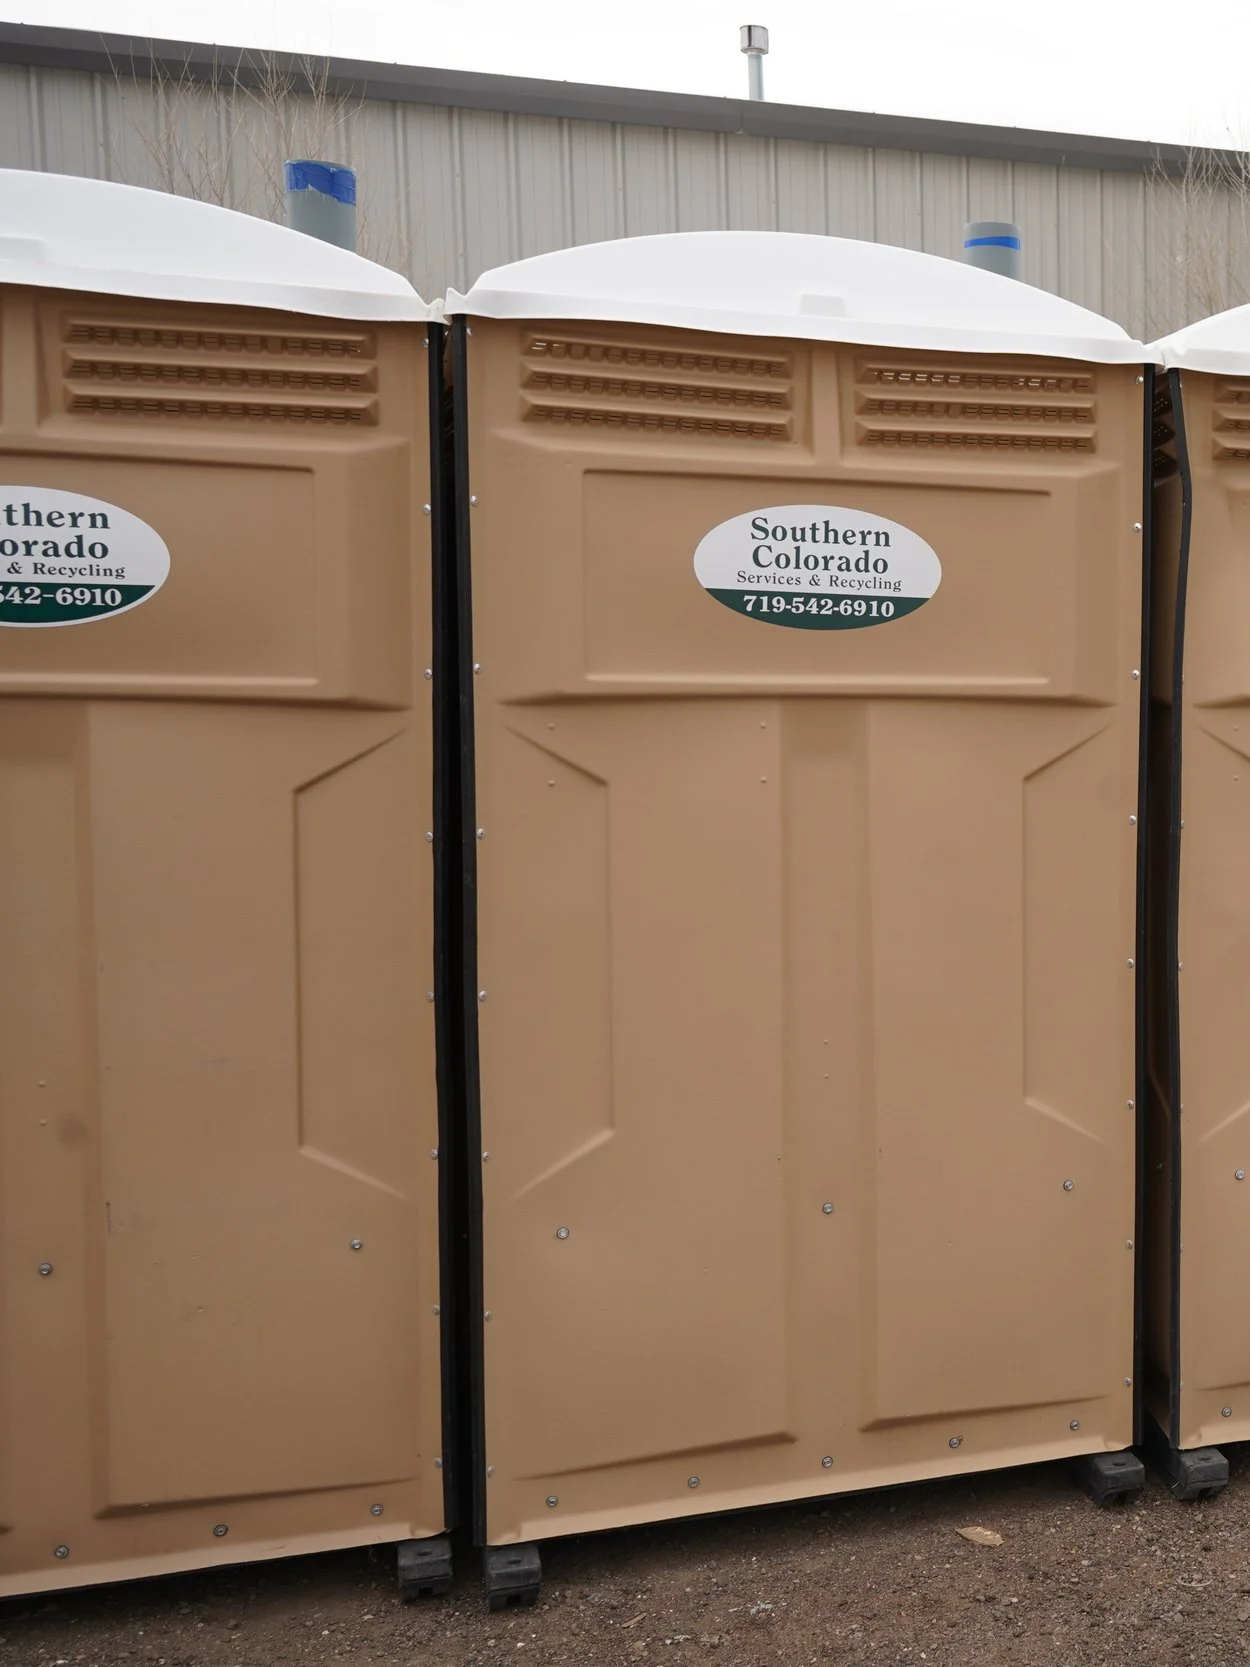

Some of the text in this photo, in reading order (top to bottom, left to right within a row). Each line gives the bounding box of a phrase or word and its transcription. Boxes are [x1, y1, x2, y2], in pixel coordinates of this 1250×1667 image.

[0, 502, 110, 530] thern
[751, 516, 891, 547] Southern
[6, 561, 126, 579] & Recycling
[752, 544, 888, 574] Colorado
[737, 570, 902, 592] Services & Recycling
[0, 586, 122, 606] 42-6910
[743, 595, 895, 617] 719-542-6910
